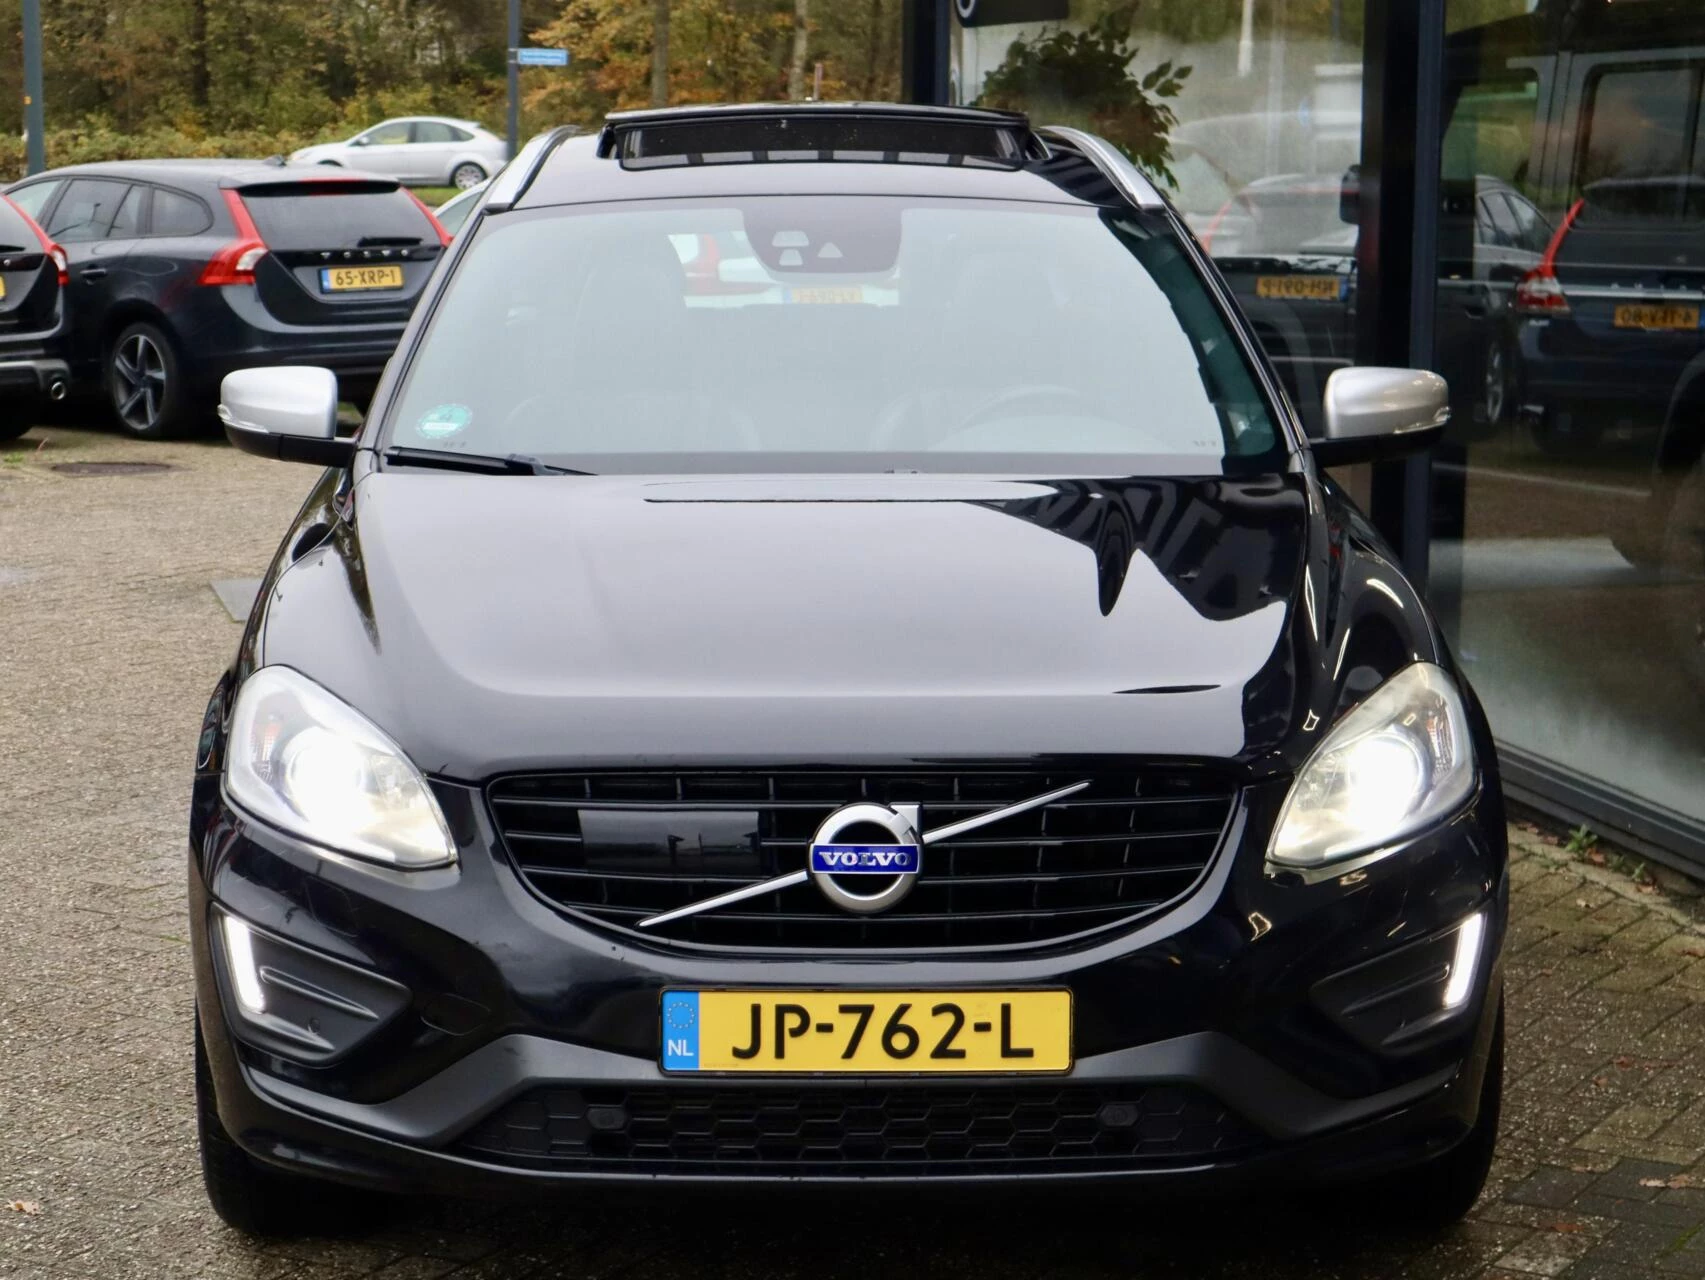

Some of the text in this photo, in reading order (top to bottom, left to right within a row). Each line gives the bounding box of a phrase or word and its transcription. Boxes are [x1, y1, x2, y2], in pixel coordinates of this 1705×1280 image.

[335, 269, 396, 286] 65-XRP-1
[818, 851, 911, 866] VOLVO
[732, 1003, 1034, 1060] JP-762-L
[667, 1039, 694, 1057] NL
